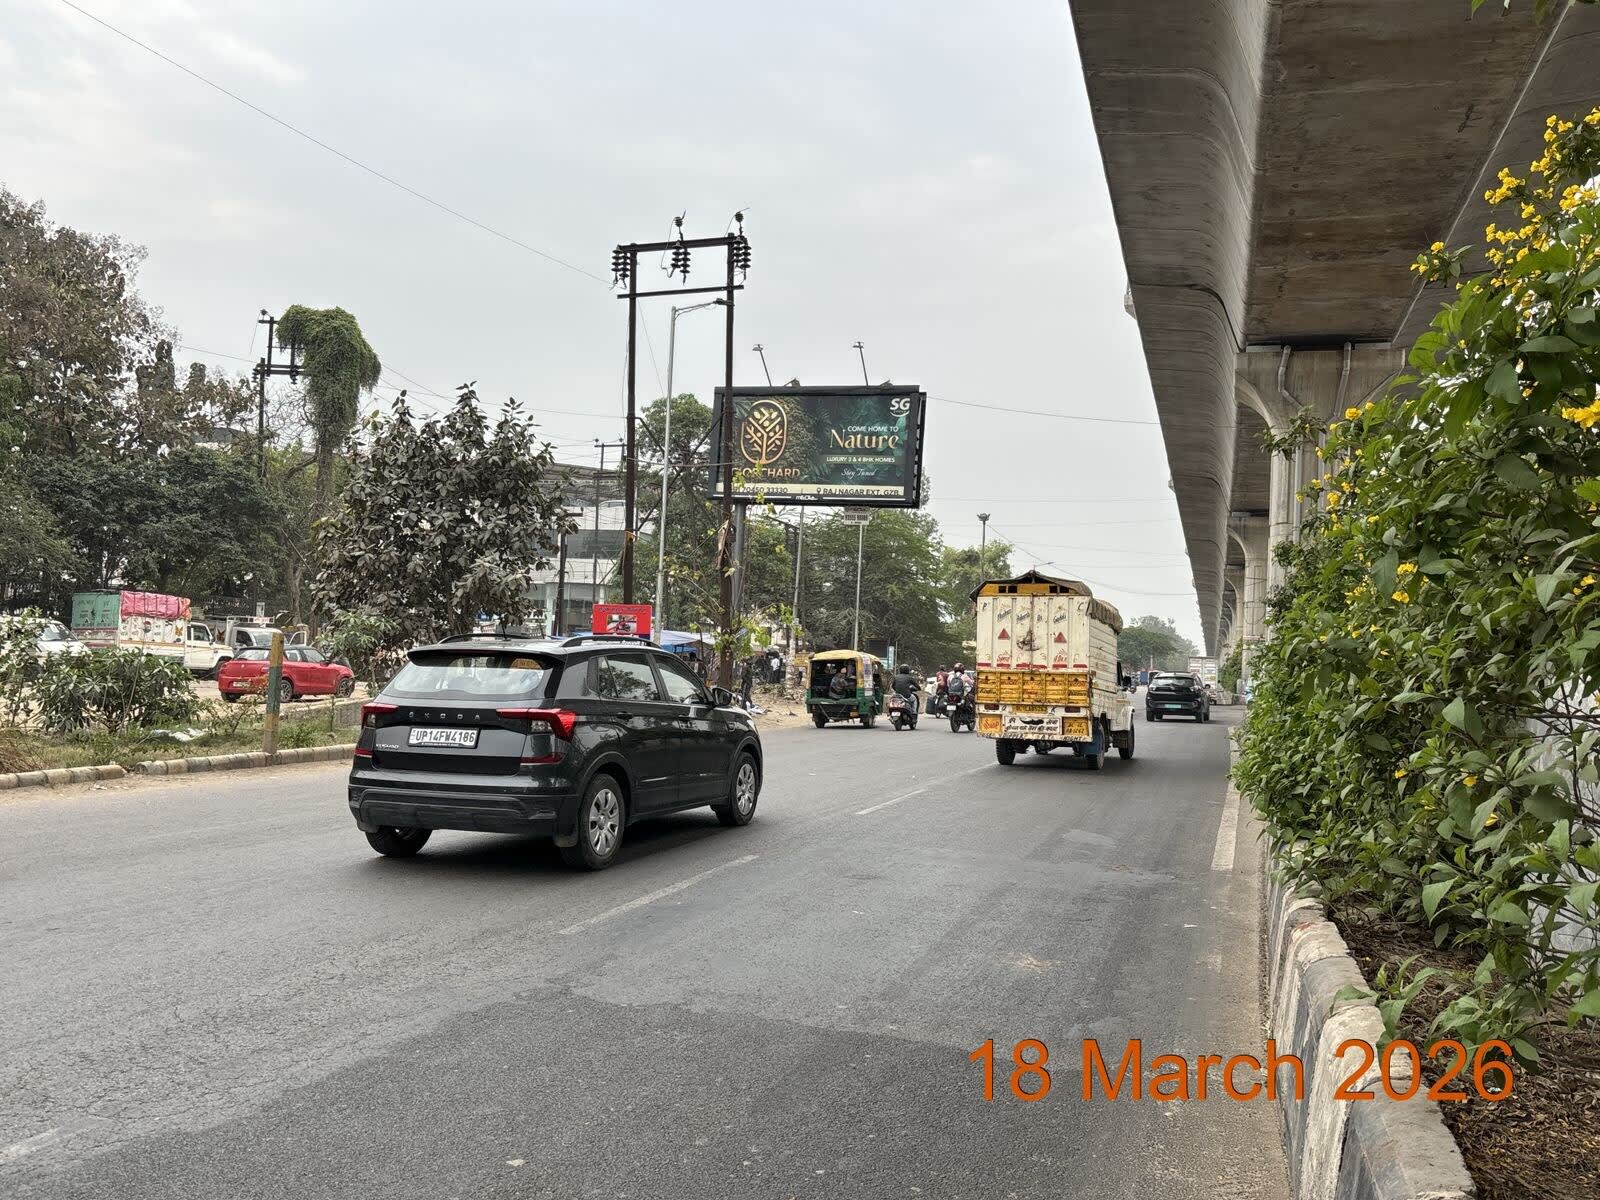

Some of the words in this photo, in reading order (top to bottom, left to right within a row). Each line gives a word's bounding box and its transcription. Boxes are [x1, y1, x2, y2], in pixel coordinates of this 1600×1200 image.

[889, 398, 911, 411] SG
[890, 425, 899, 433] TO
[829, 429, 899, 449] Nature
[838, 488, 865, 496] NAGAR
